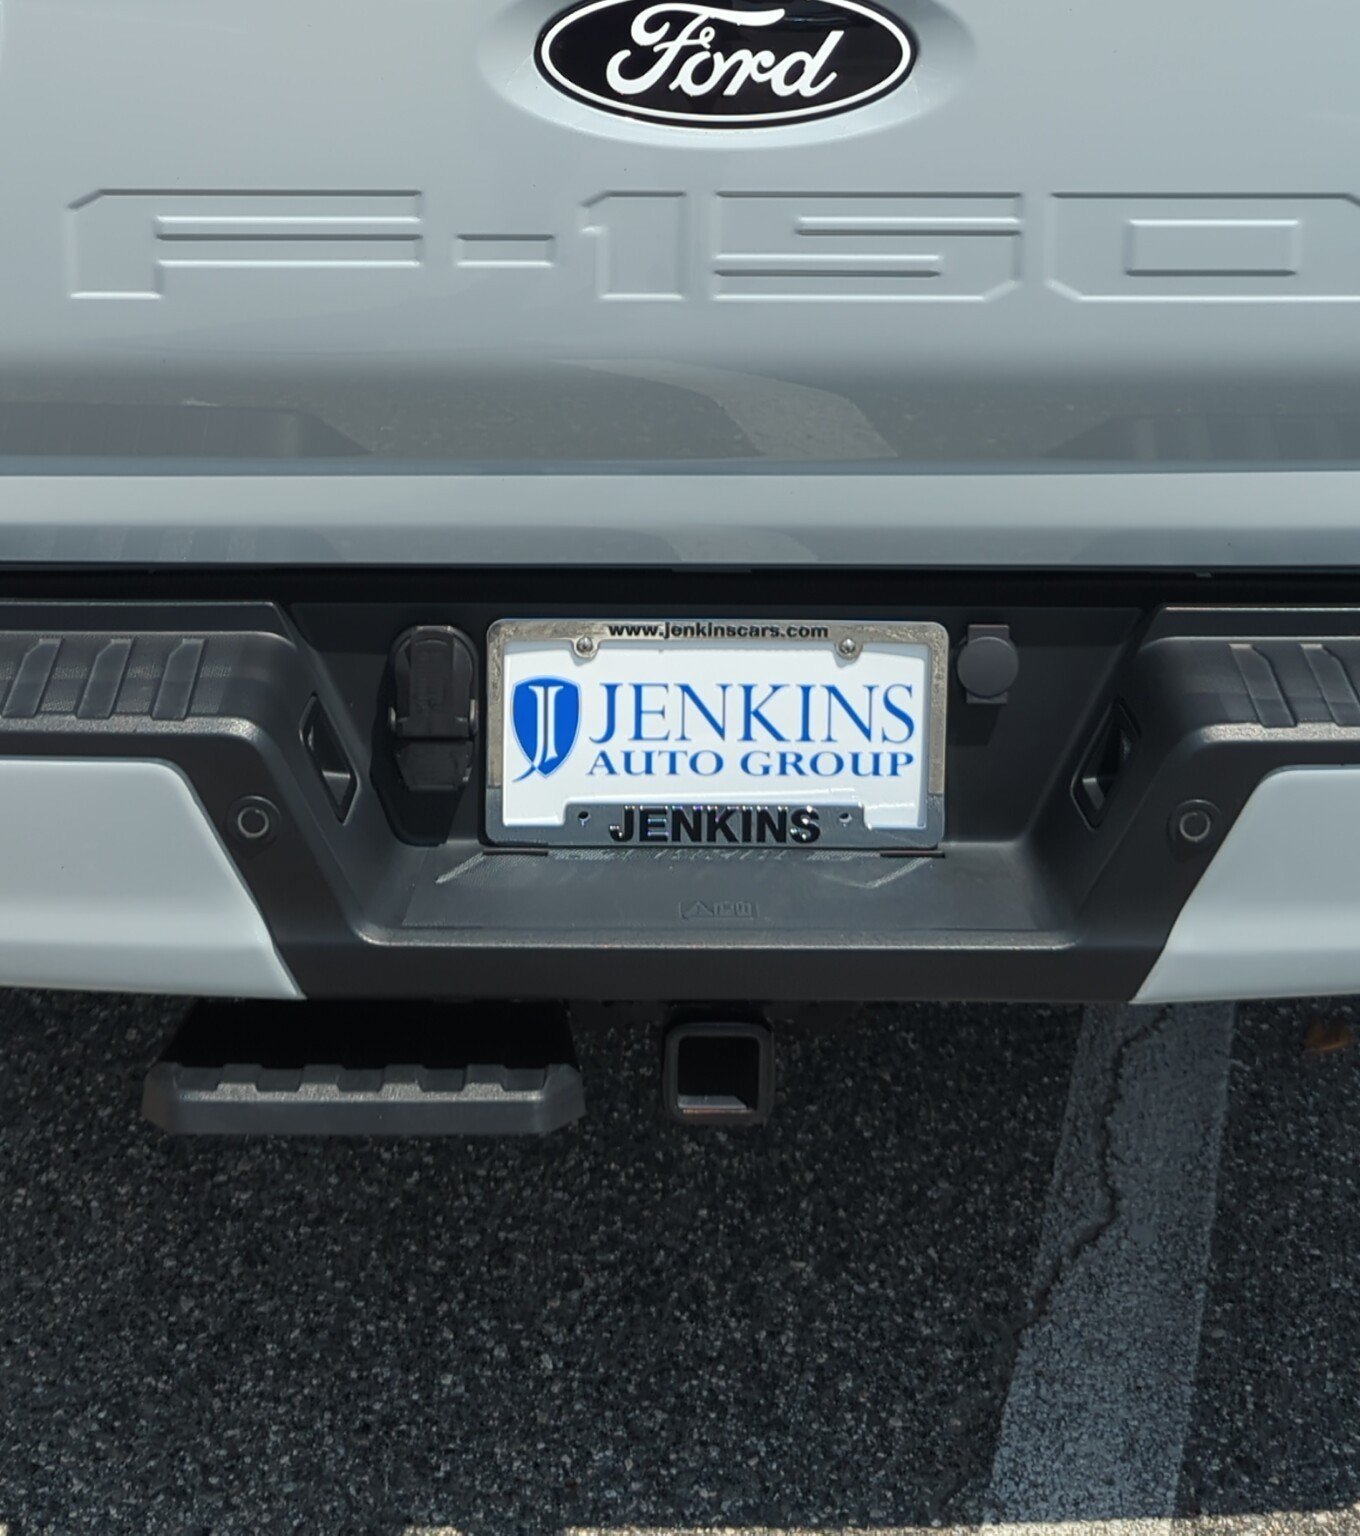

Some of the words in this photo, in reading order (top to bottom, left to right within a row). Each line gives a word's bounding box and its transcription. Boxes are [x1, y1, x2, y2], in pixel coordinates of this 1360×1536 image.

[606, 3, 844, 98] Ford
[608, 622, 829, 640] www.jenkinscars.com
[589, 684, 915, 744] JENKINS
[586, 750, 725, 777] AUTO
[741, 750, 915, 778] GROUP
[609, 805, 822, 844] JENKINS
